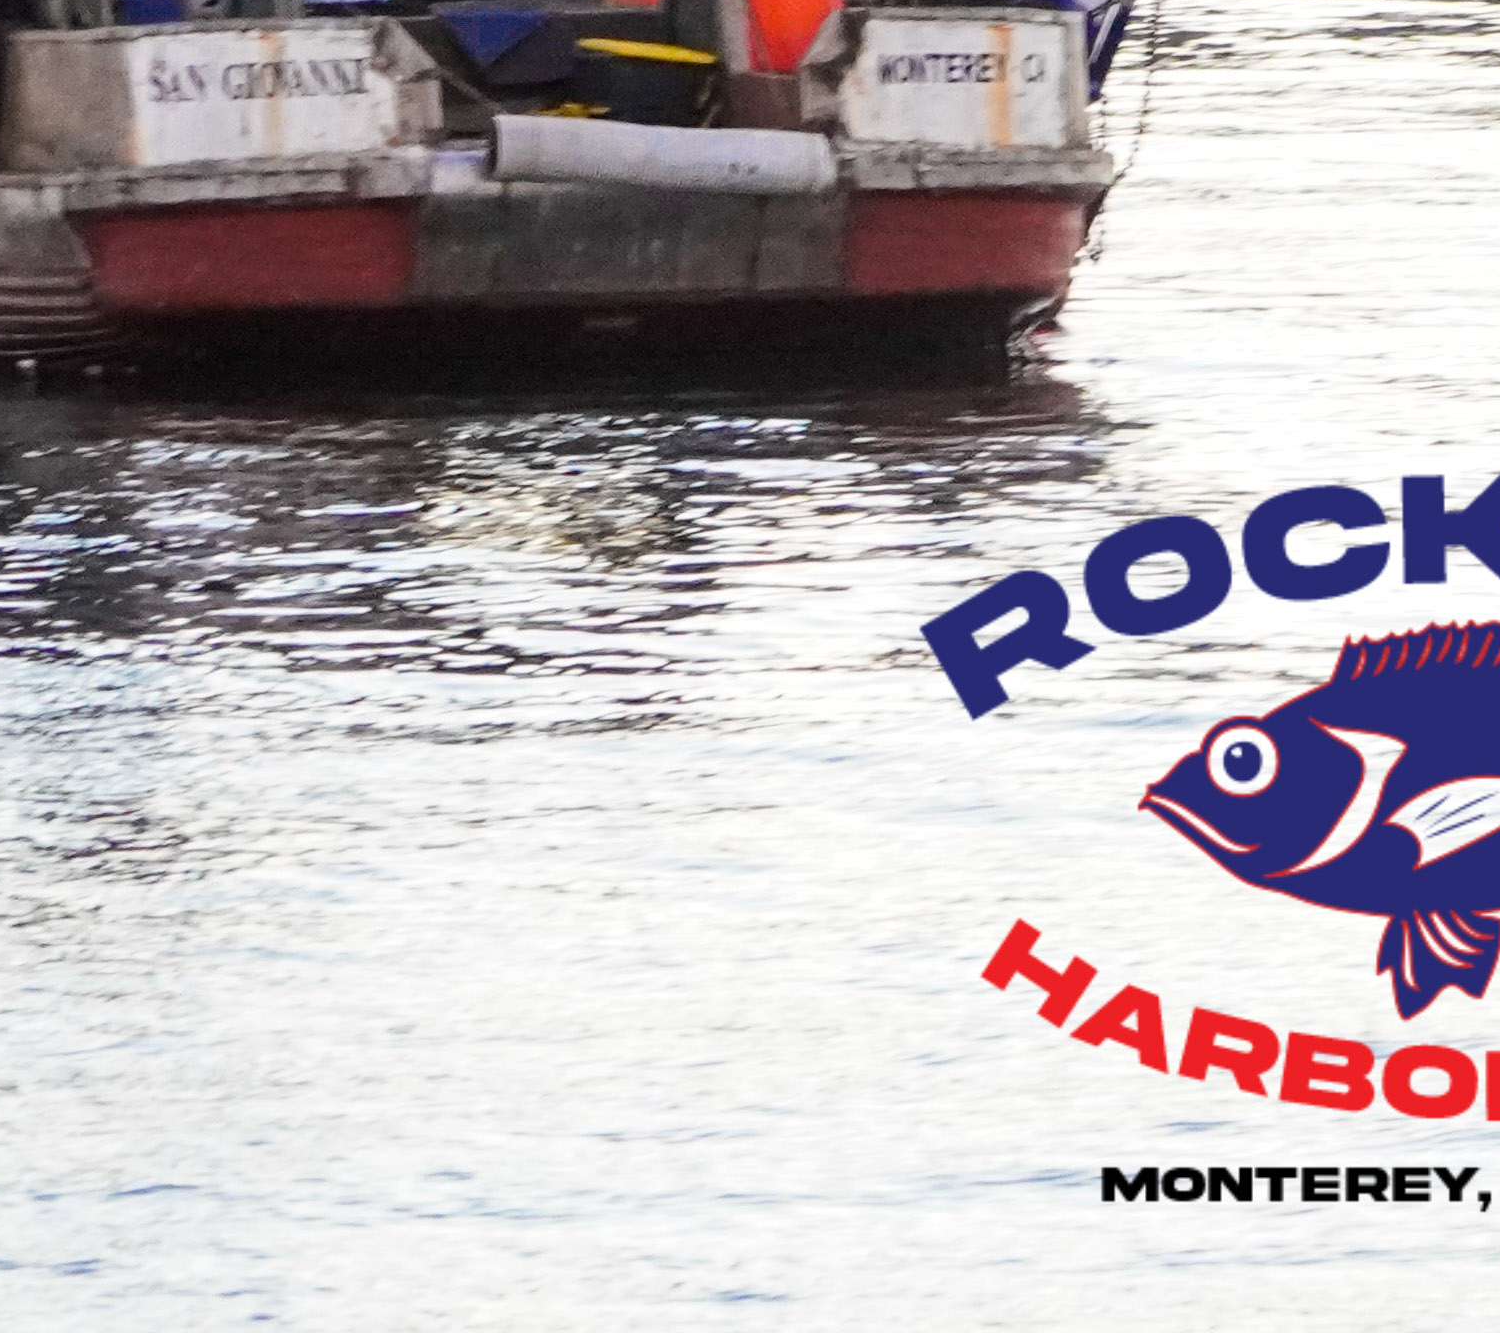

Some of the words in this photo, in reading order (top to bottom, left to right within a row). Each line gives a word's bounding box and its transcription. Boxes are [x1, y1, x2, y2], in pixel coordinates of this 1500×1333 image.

[148, 59, 208, 102] SAN
[221, 58, 370, 100] GIOVANNI
[876, 52, 1008, 84] MONTEREY
